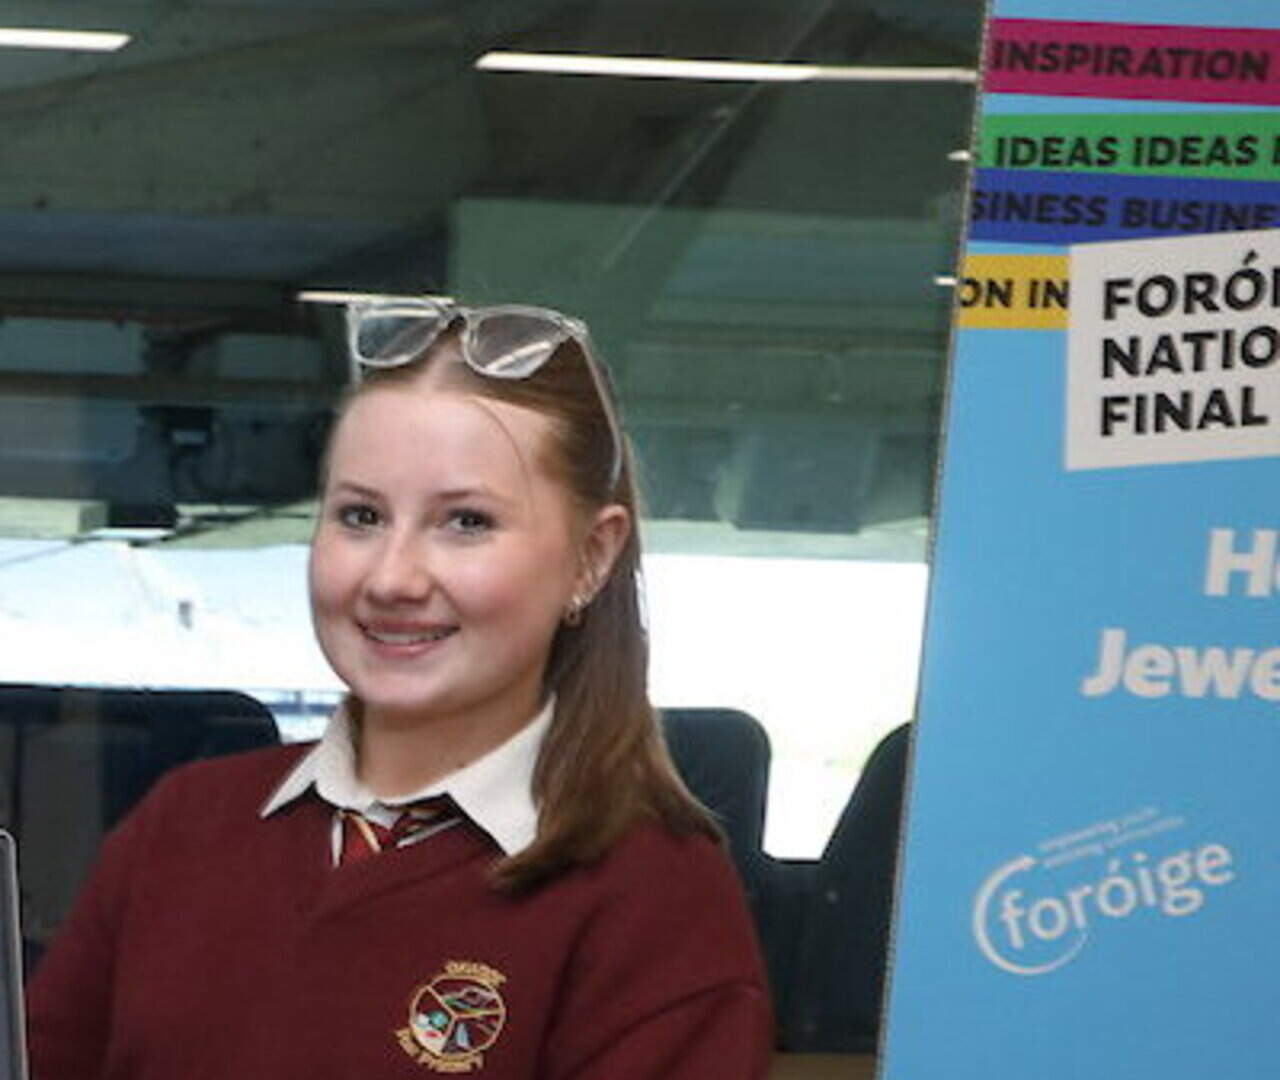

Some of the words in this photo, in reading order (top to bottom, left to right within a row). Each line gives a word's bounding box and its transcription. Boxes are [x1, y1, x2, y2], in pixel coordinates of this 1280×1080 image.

[991, 39, 1271, 83] INSPIRATION
[995, 136, 1120, 168] IDEAS
[1132, 135, 1260, 168] IDEAS
[1102, 325, 1280, 379] NATIO
[1100, 386, 1269, 437] FINAL
[1203, 528, 1280, 598] H
[1000, 841, 1235, 949] foróige
